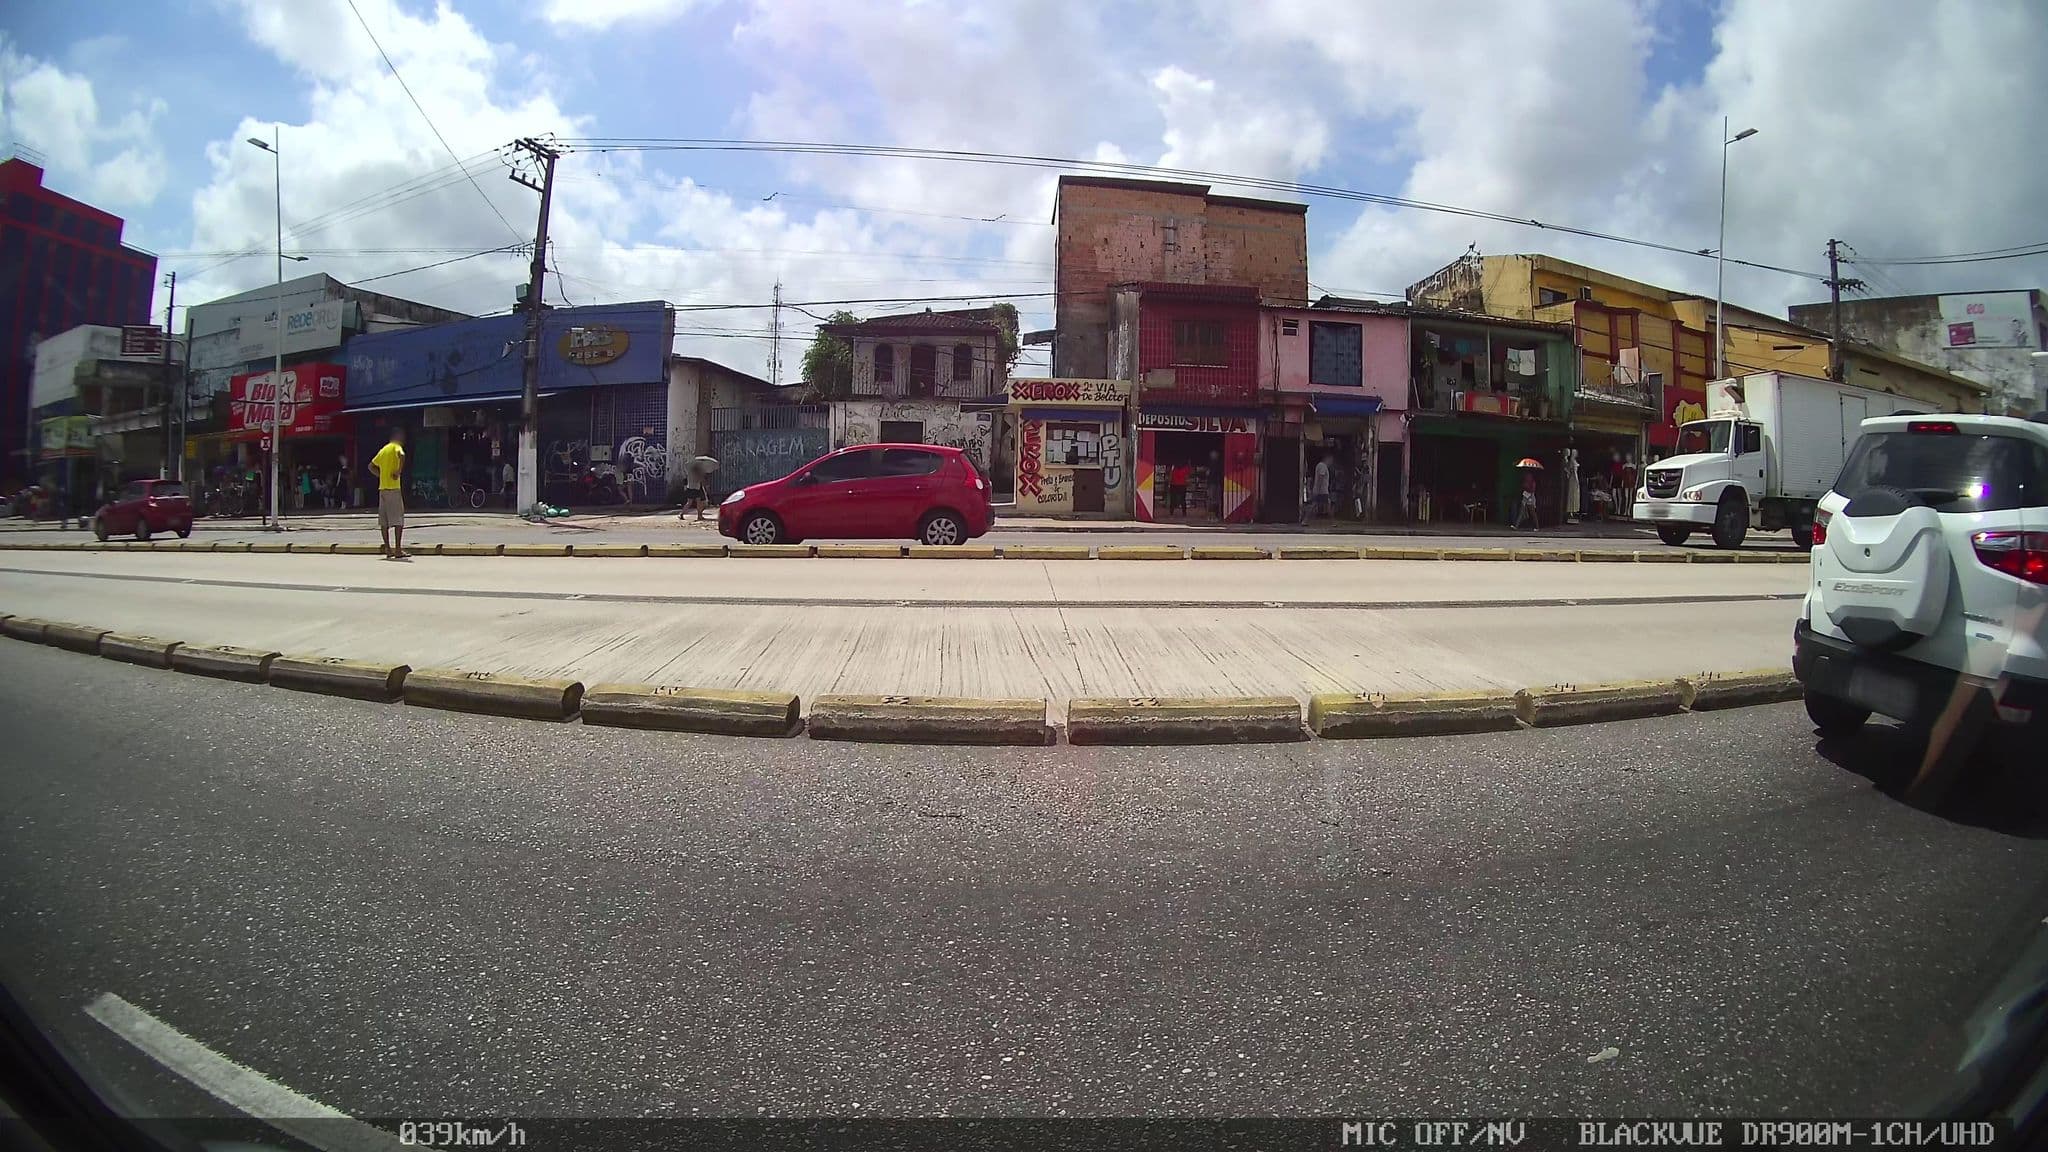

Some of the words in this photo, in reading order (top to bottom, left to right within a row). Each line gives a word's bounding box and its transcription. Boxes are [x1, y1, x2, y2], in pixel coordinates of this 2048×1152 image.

[1011, 380, 1081, 402] XEROX
[1096, 382, 1117, 393] VIA
[1186, 416, 1248, 432] SILVA
